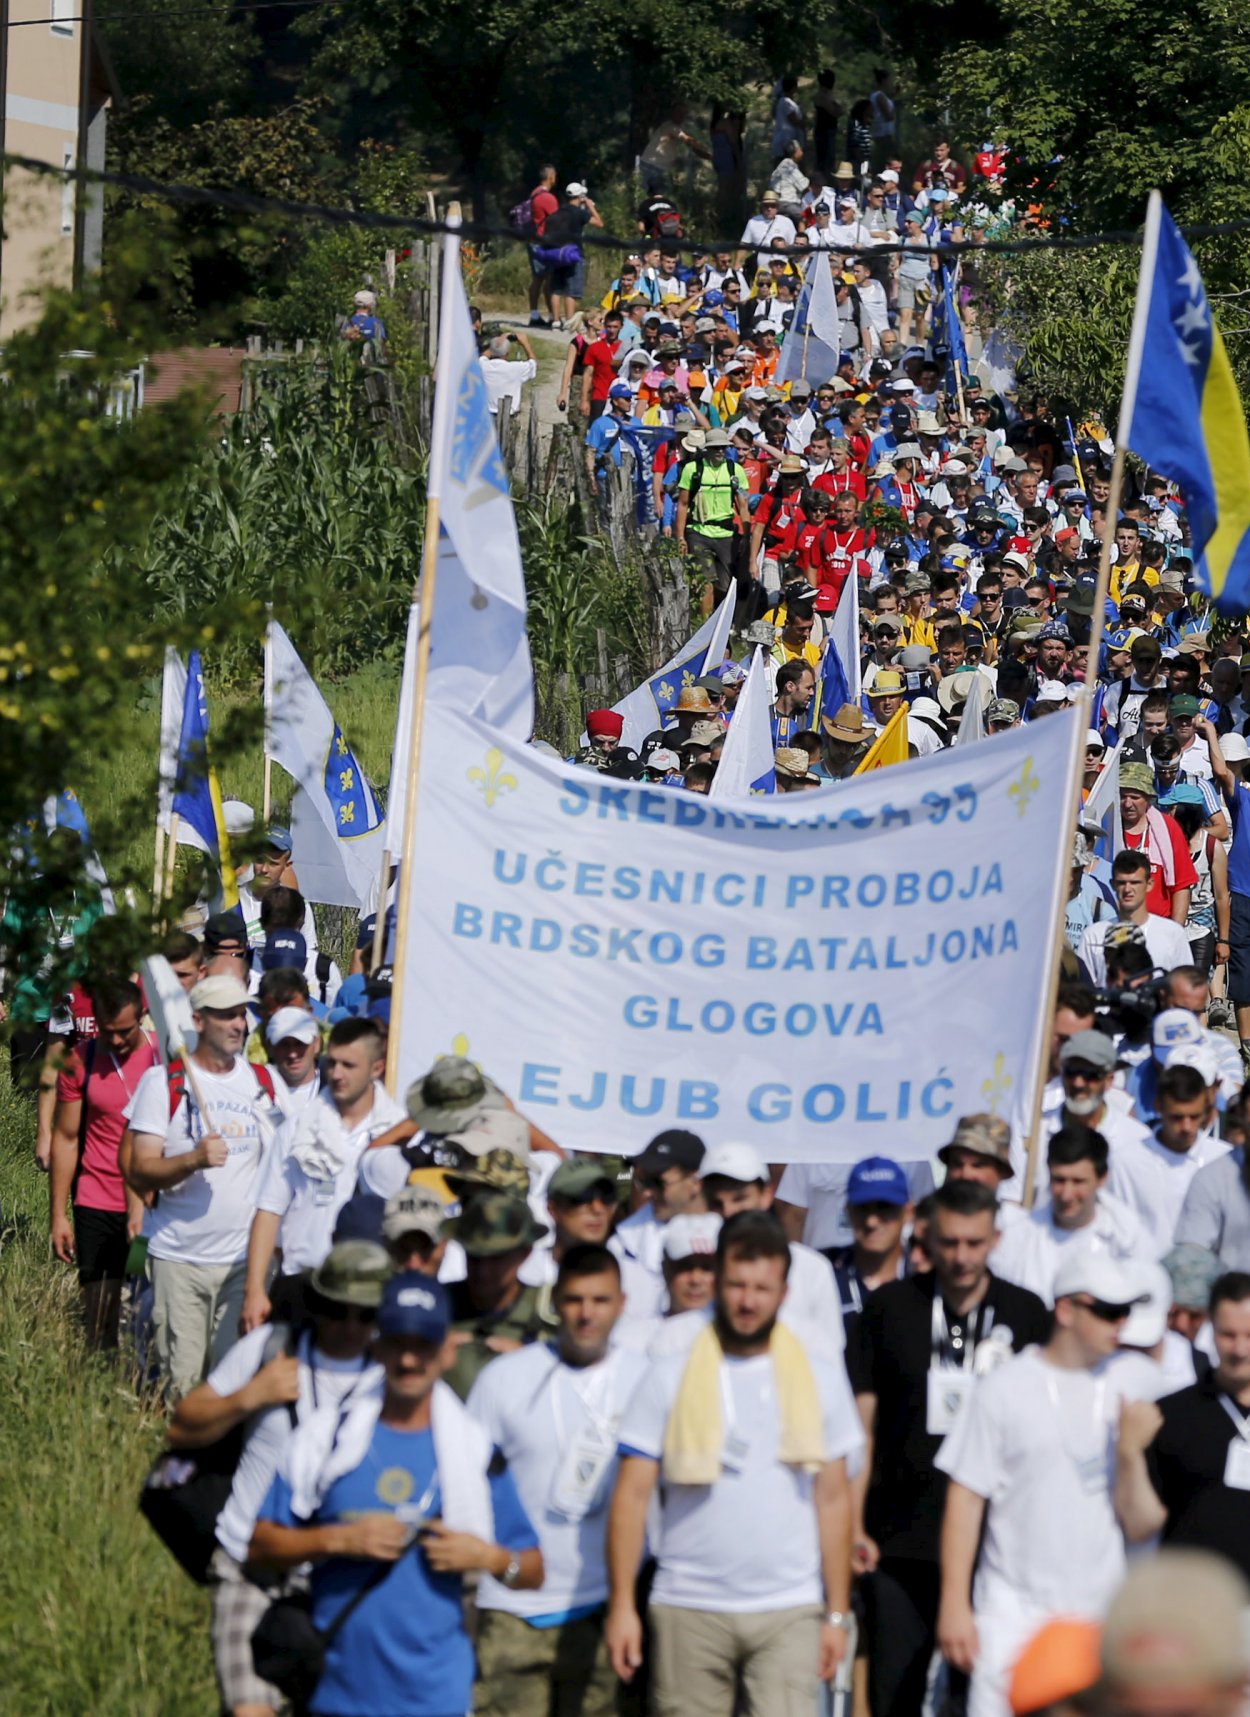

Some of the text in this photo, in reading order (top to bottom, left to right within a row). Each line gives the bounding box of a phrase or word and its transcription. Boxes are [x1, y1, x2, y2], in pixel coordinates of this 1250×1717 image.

[560, 779, 978, 829] SREBRCA 95
[492, 847, 1009, 910] UČESNICI PROBOJA
[452, 902, 1022, 974] BRDSKOG BATALJONA
[623, 994, 886, 1039] GLOGOVA
[519, 1062, 956, 1125] EJUB GOLIĆ
